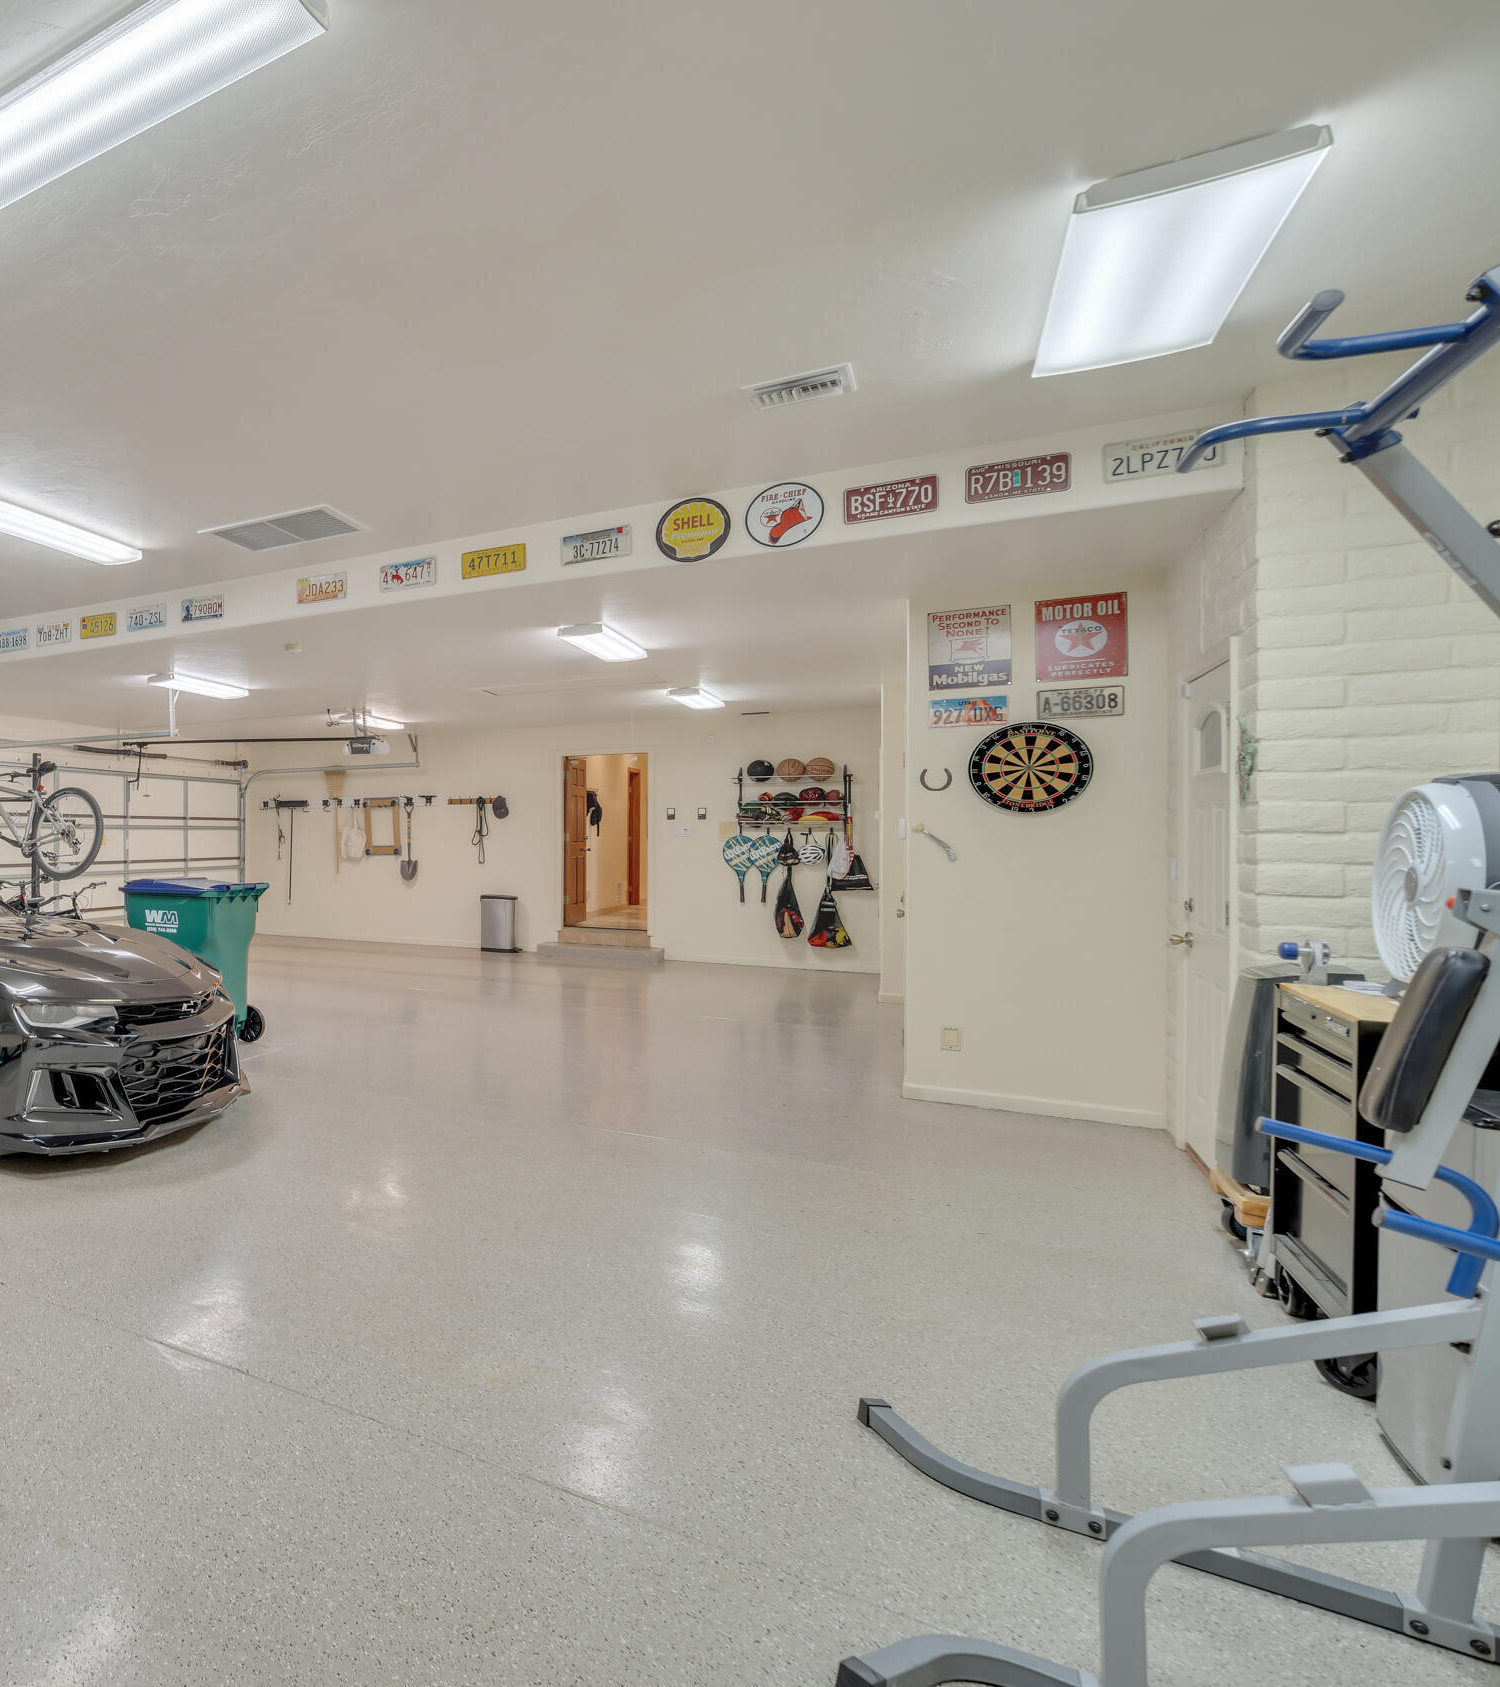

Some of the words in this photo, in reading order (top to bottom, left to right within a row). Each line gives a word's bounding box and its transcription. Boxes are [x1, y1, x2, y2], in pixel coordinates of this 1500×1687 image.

[1131, 434, 1195, 452] CALIFORNIA
[994, 458, 1042, 470] MISSOURI
[1112, 446, 1216, 476] 2LPZ7J
[1025, 462, 1066, 487] 139
[870, 482, 911, 493] ARIZONA
[851, 492, 886, 515] BSF
[896, 485, 932, 507] 770
[857, 511, 879, 519] GRAND
[880, 507, 906, 516] CANYON
[906, 503, 926, 512] STATE
[673, 513, 714, 531] SHELL
[468, 550, 517, 570] 47T711
[306, 579, 344, 598] JDA233
[932, 609, 1007, 622] PERFORMANCE
[1042, 602, 1093, 621] MOTOR
[1097, 599, 1121, 616] OIL
[938, 620, 982, 630] SECOND
[984, 617, 1000, 626] TO
[1060, 626, 1102, 635] TEXACO
[954, 663, 985, 673] NEW
[1048, 661, 1115, 671] LUBRICATES
[1051, 667, 1112, 677] PERFECTLY
[932, 671, 1008, 686] Mobilgas
[1042, 693, 1118, 713] A-66308
[933, 708, 962, 725] 927
[145, 909, 179, 924] WM
